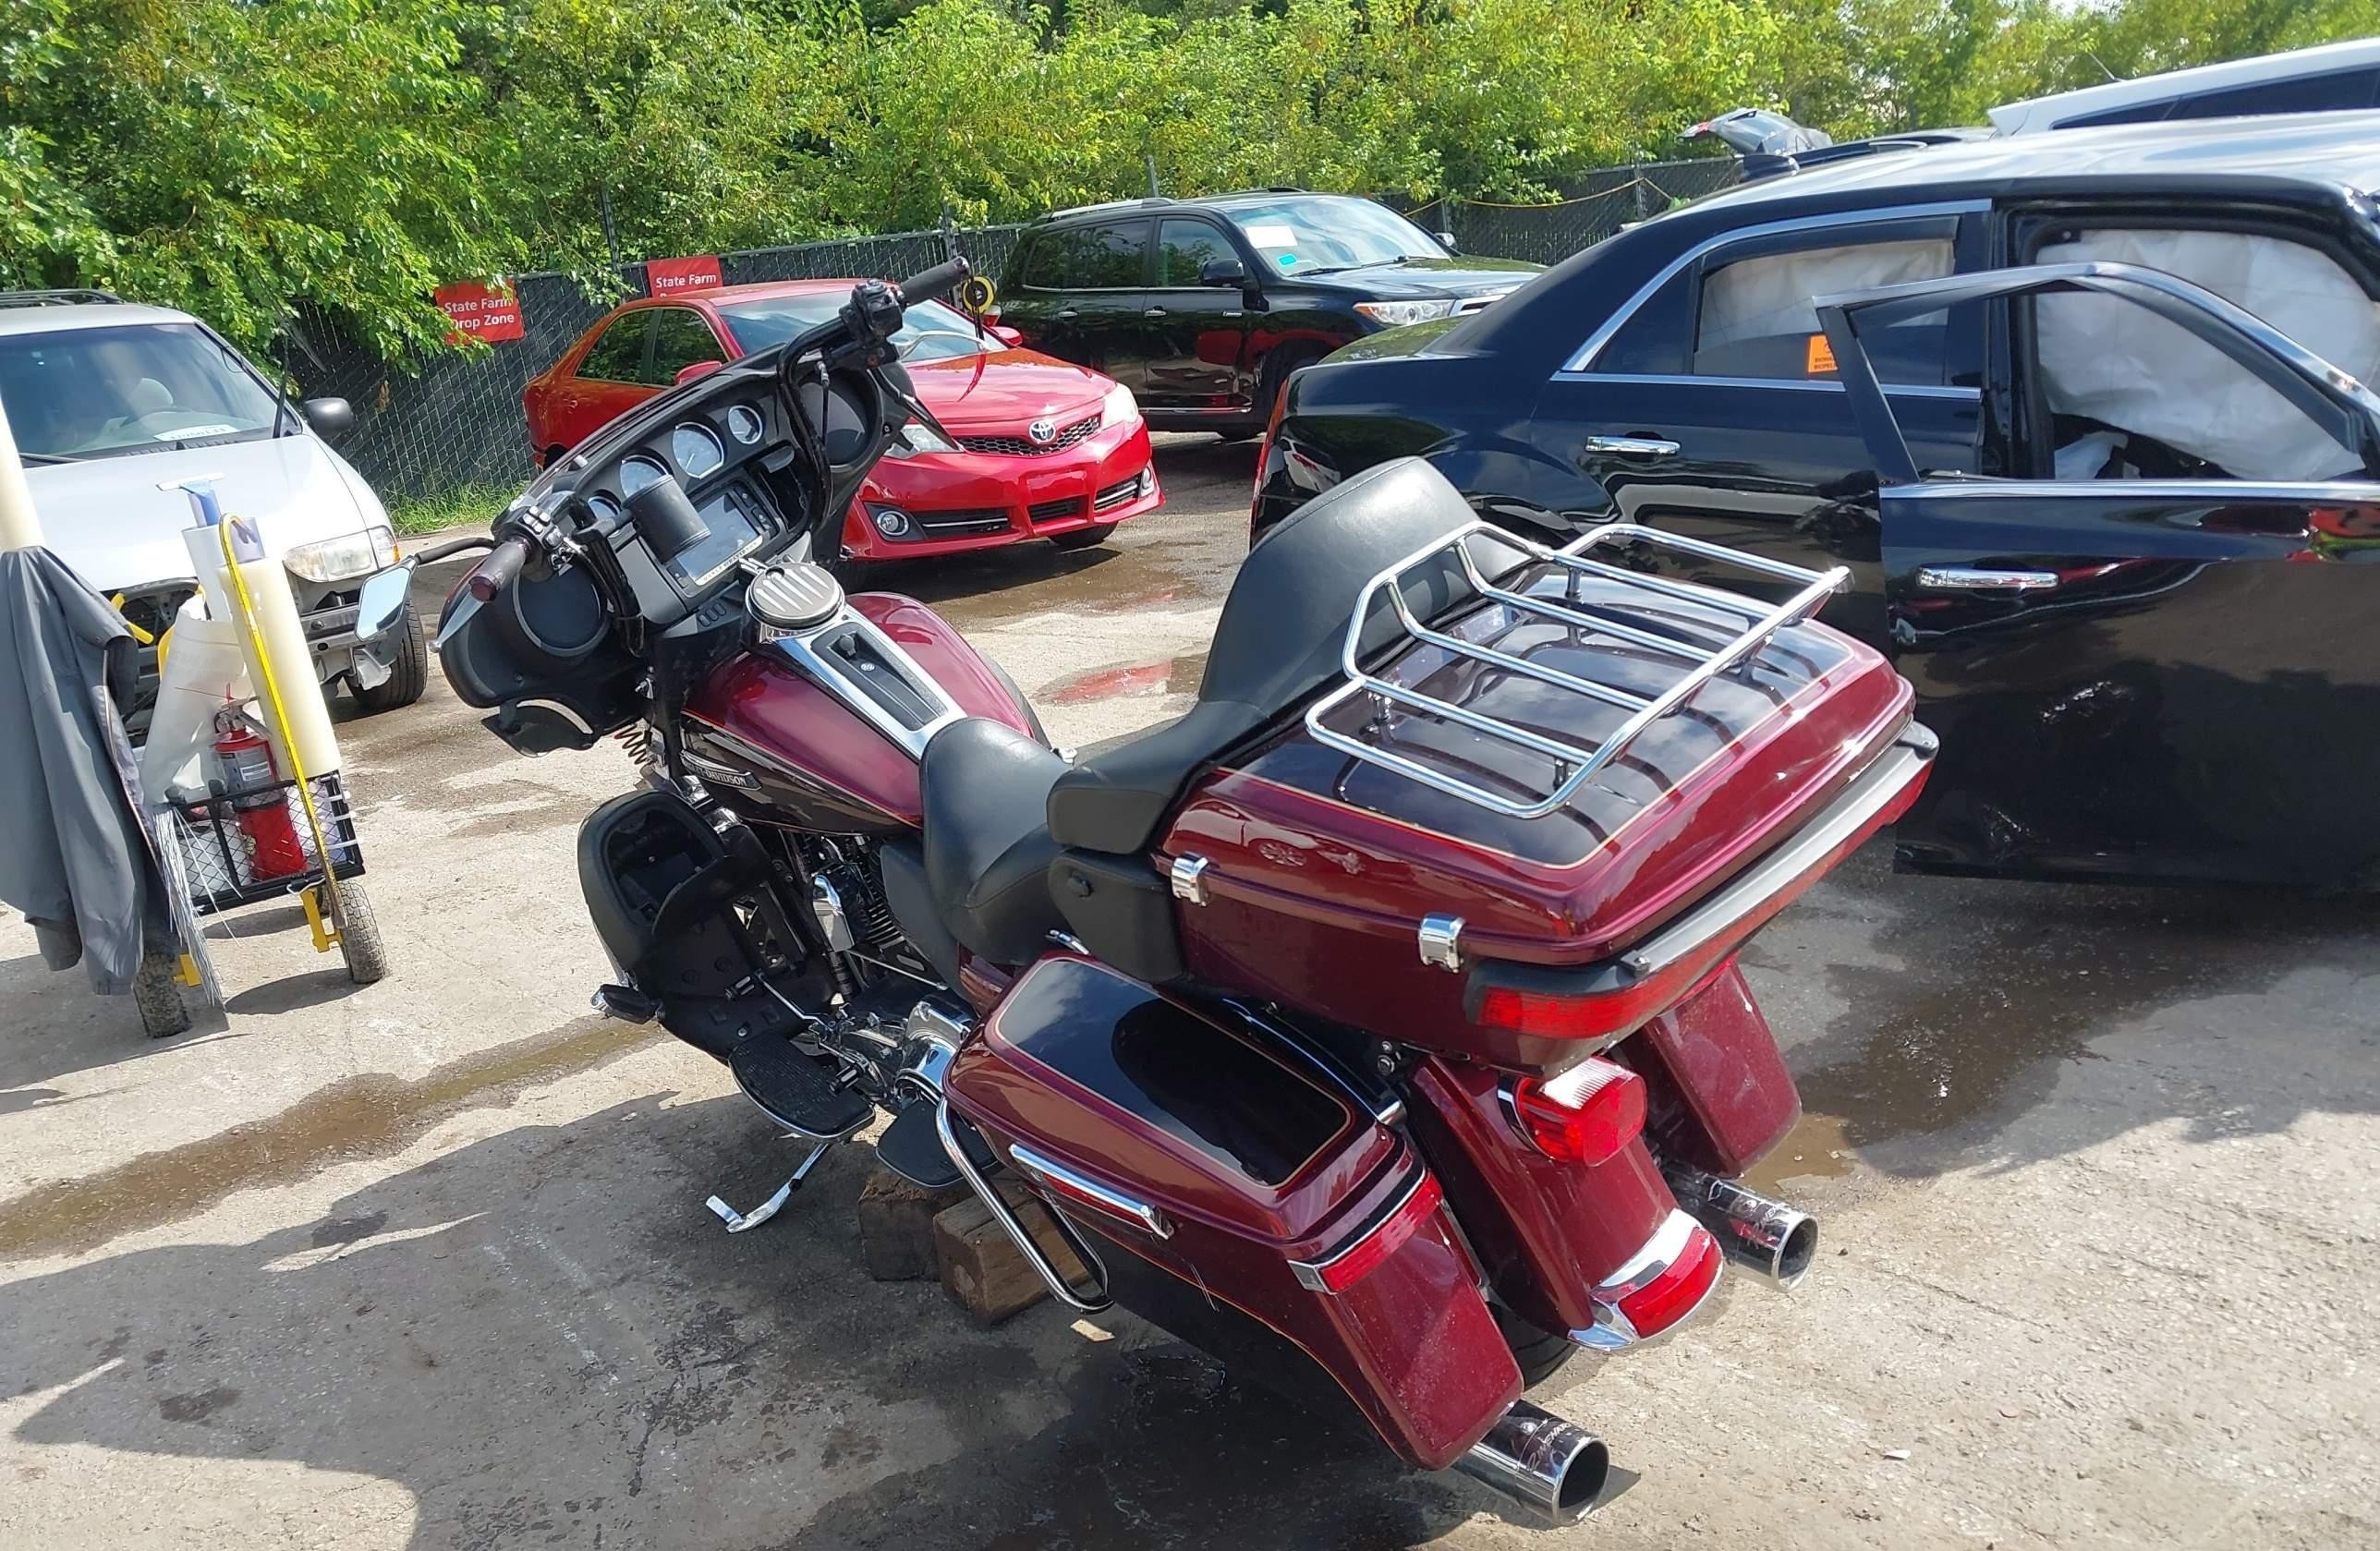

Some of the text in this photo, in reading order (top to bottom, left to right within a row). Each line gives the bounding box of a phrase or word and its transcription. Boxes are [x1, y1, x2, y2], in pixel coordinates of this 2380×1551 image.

[656, 273, 717, 288] State Farm
[444, 297, 512, 313] State Farm
[483, 314, 515, 326] Zone
